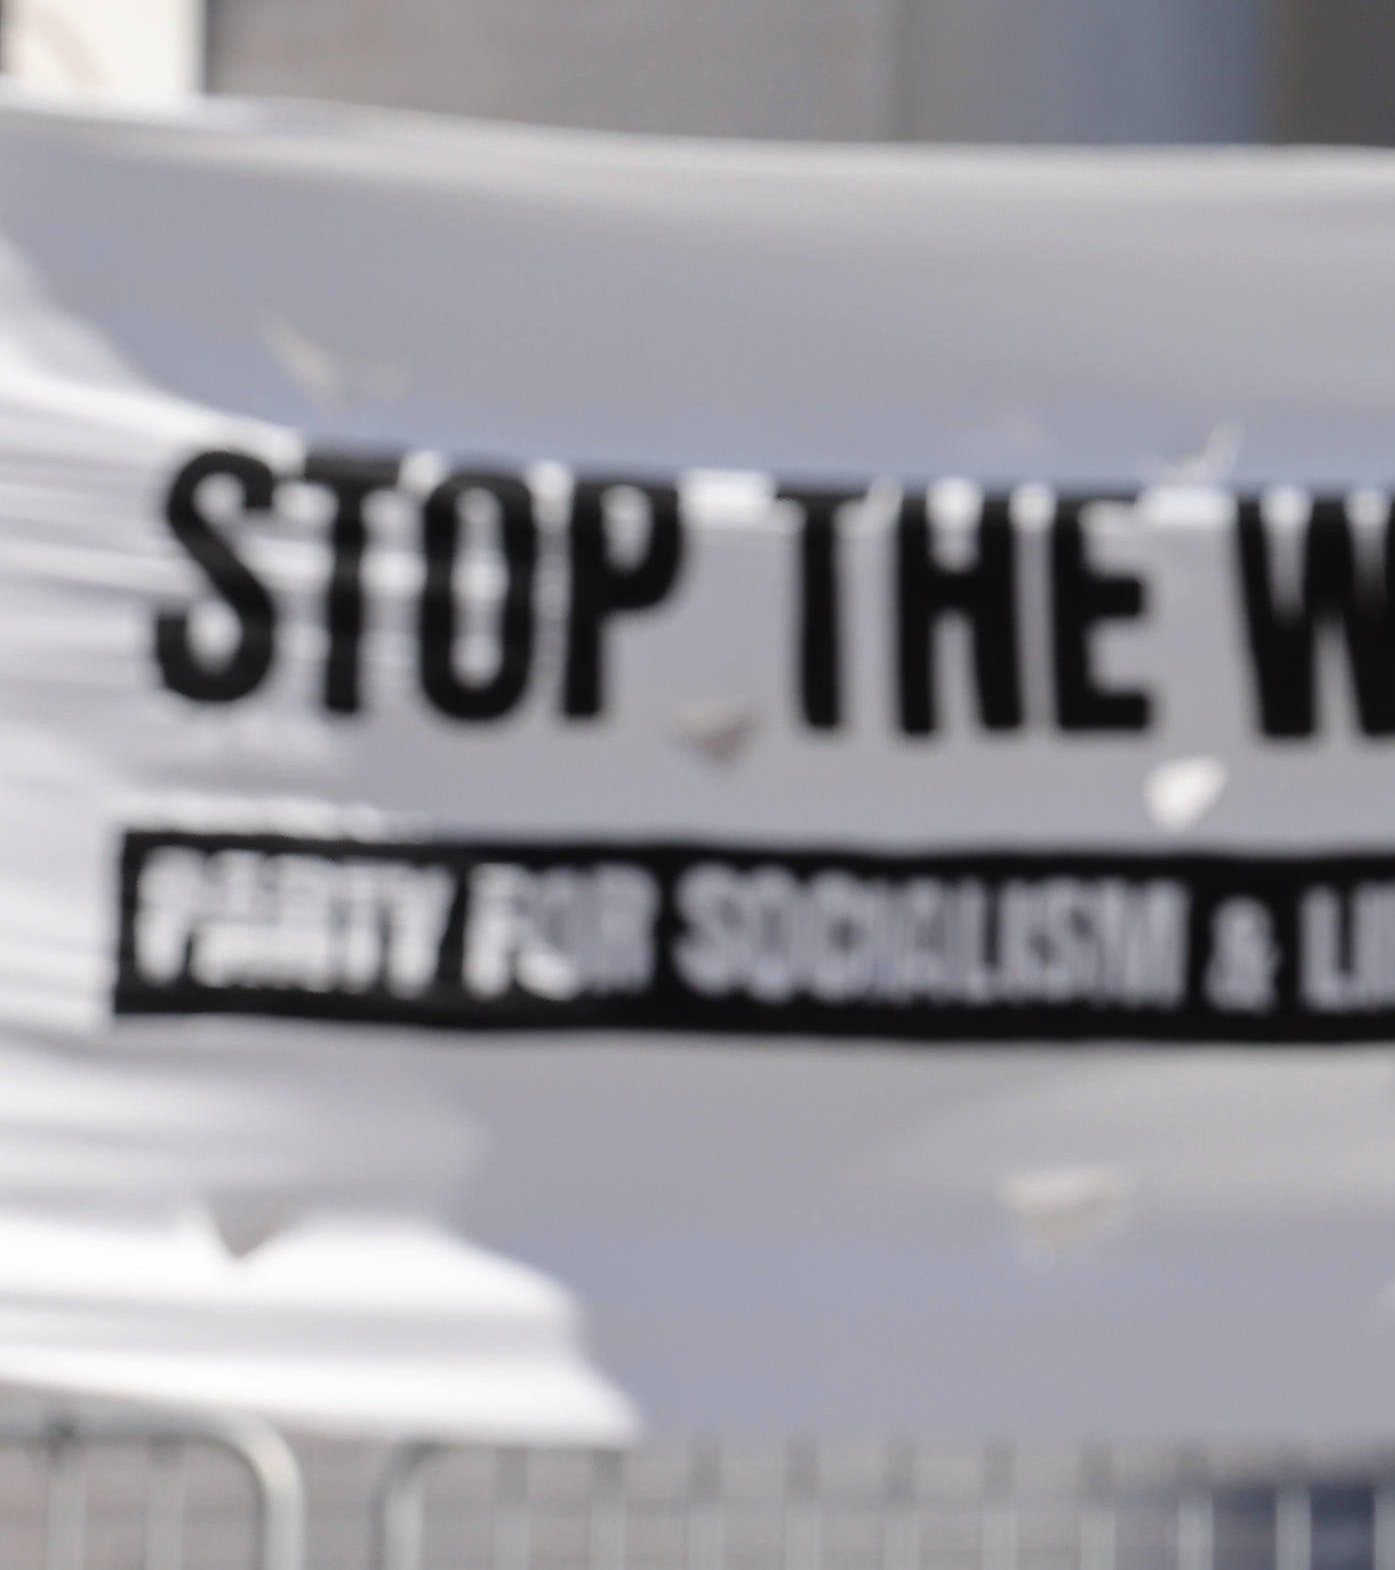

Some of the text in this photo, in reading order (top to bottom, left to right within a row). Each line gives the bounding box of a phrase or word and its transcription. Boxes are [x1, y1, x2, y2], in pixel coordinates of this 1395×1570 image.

[150, 444, 684, 722] STOP
[772, 484, 1155, 738] THE
[131, 844, 455, 997] PARTY
[456, 859, 661, 1002] FOR
[672, 861, 1191, 1010] SOCIALISM
[1206, 894, 1281, 1013] &
